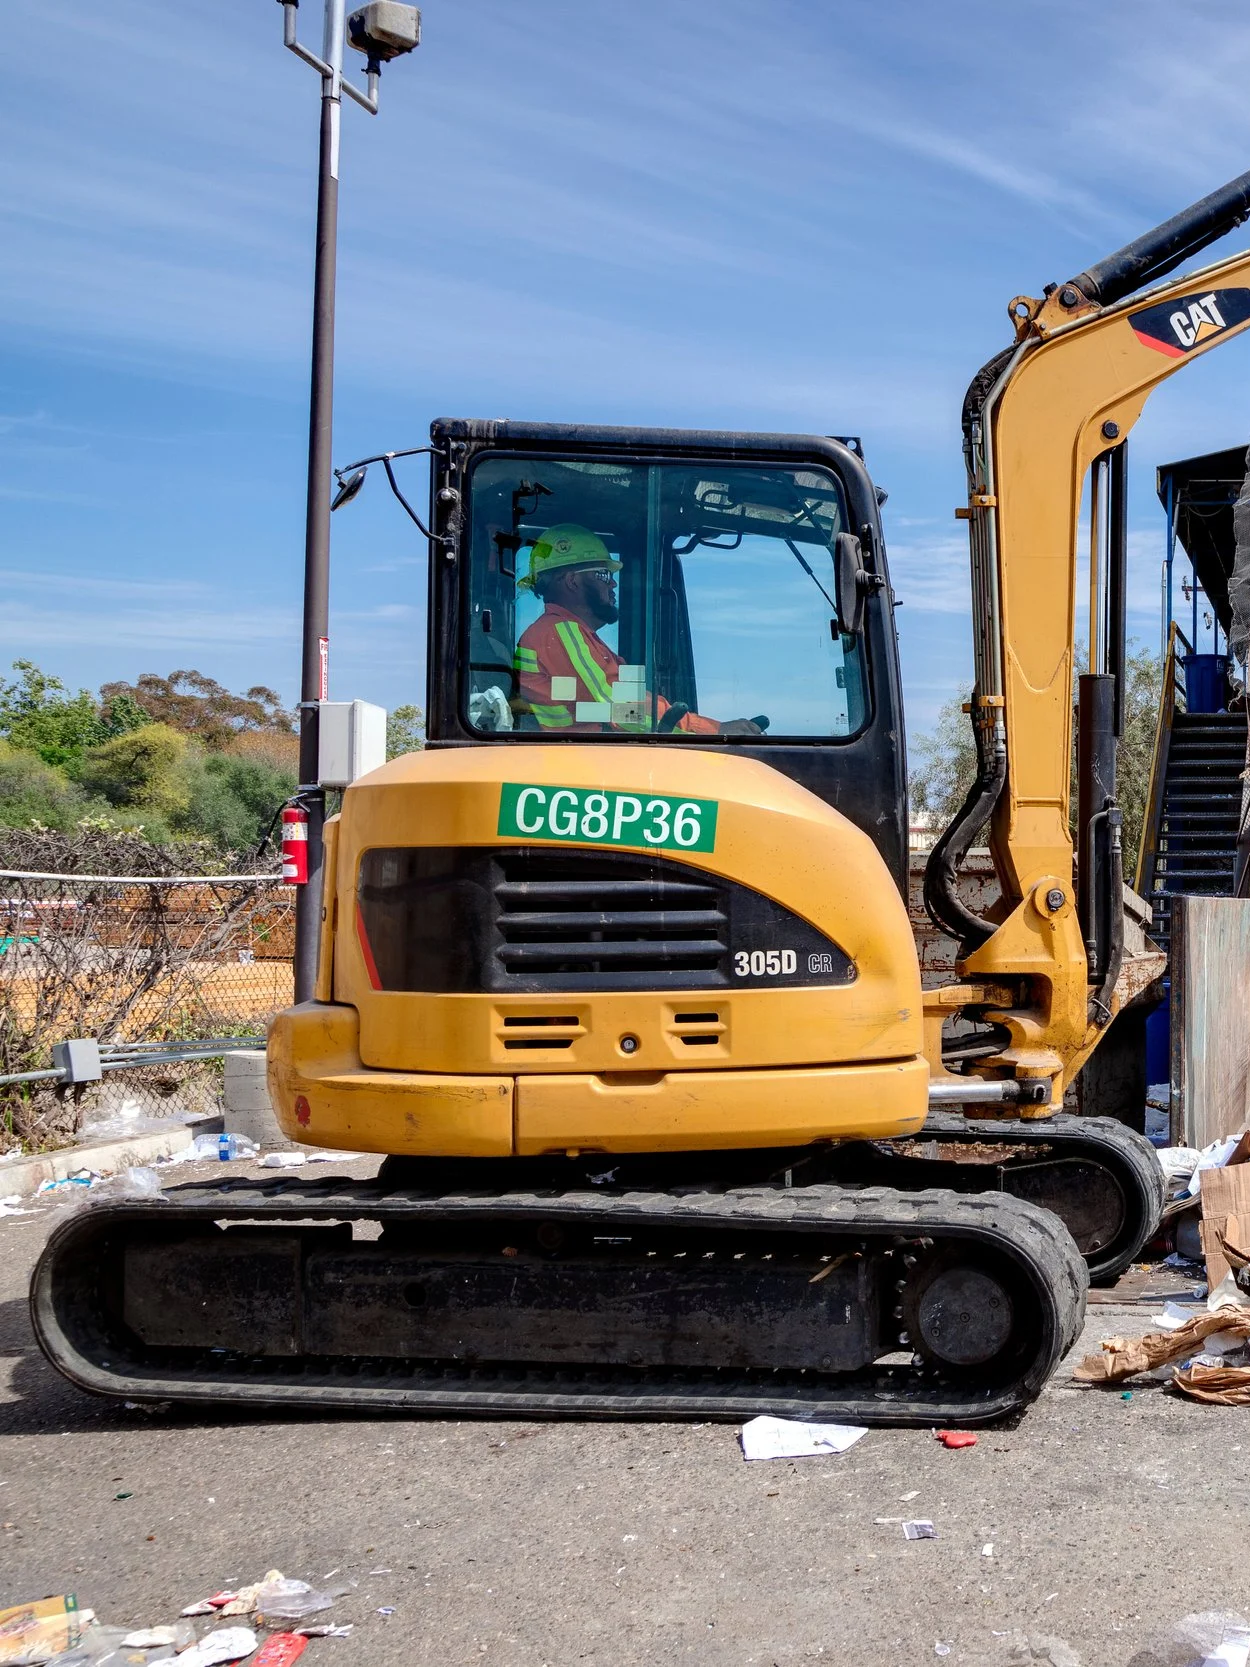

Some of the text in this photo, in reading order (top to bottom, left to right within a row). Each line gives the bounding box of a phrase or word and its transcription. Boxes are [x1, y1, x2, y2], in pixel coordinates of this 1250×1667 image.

[1169, 293, 1227, 347] CAT
[515, 787, 702, 847] CG8P36
[734, 949, 832, 977] 305D CR
